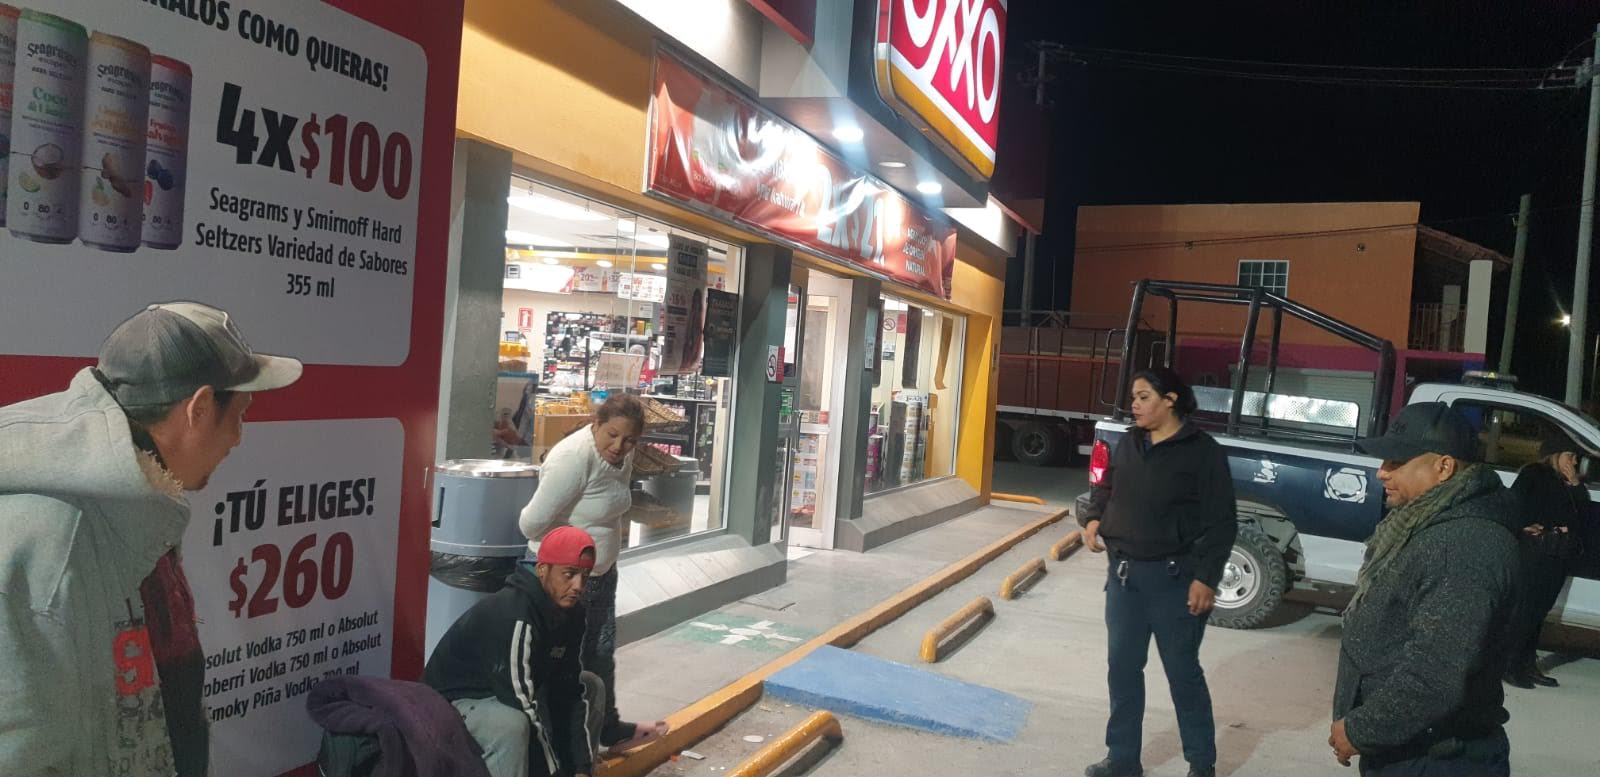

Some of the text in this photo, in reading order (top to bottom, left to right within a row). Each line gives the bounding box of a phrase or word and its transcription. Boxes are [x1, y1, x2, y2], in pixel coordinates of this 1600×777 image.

[237, 9, 299, 57] COMO
[305, 36, 389, 92] QUIERAS!
[904, 0, 1000, 124] OXXO
[210, 187, 402, 244] Seagrams y Smirnoff Hard
[195, 223, 408, 277] Seltzers Variedad de Sabores
[286, 273, 335, 299] 355 ml
[213, 477, 376, 547] ¡TÚ ELIGES!
[228, 531, 354, 619] $260
[205, 610, 379, 670] solut Vodka 750 ml o Absolut
[249, 660, 286, 684] Vodka
[290, 652, 310, 673] 750
[313, 646, 328, 665] ml
[331, 648, 338, 659] o
[342, 632, 382, 656] Absolut
[253, 687, 281, 710] Piña
